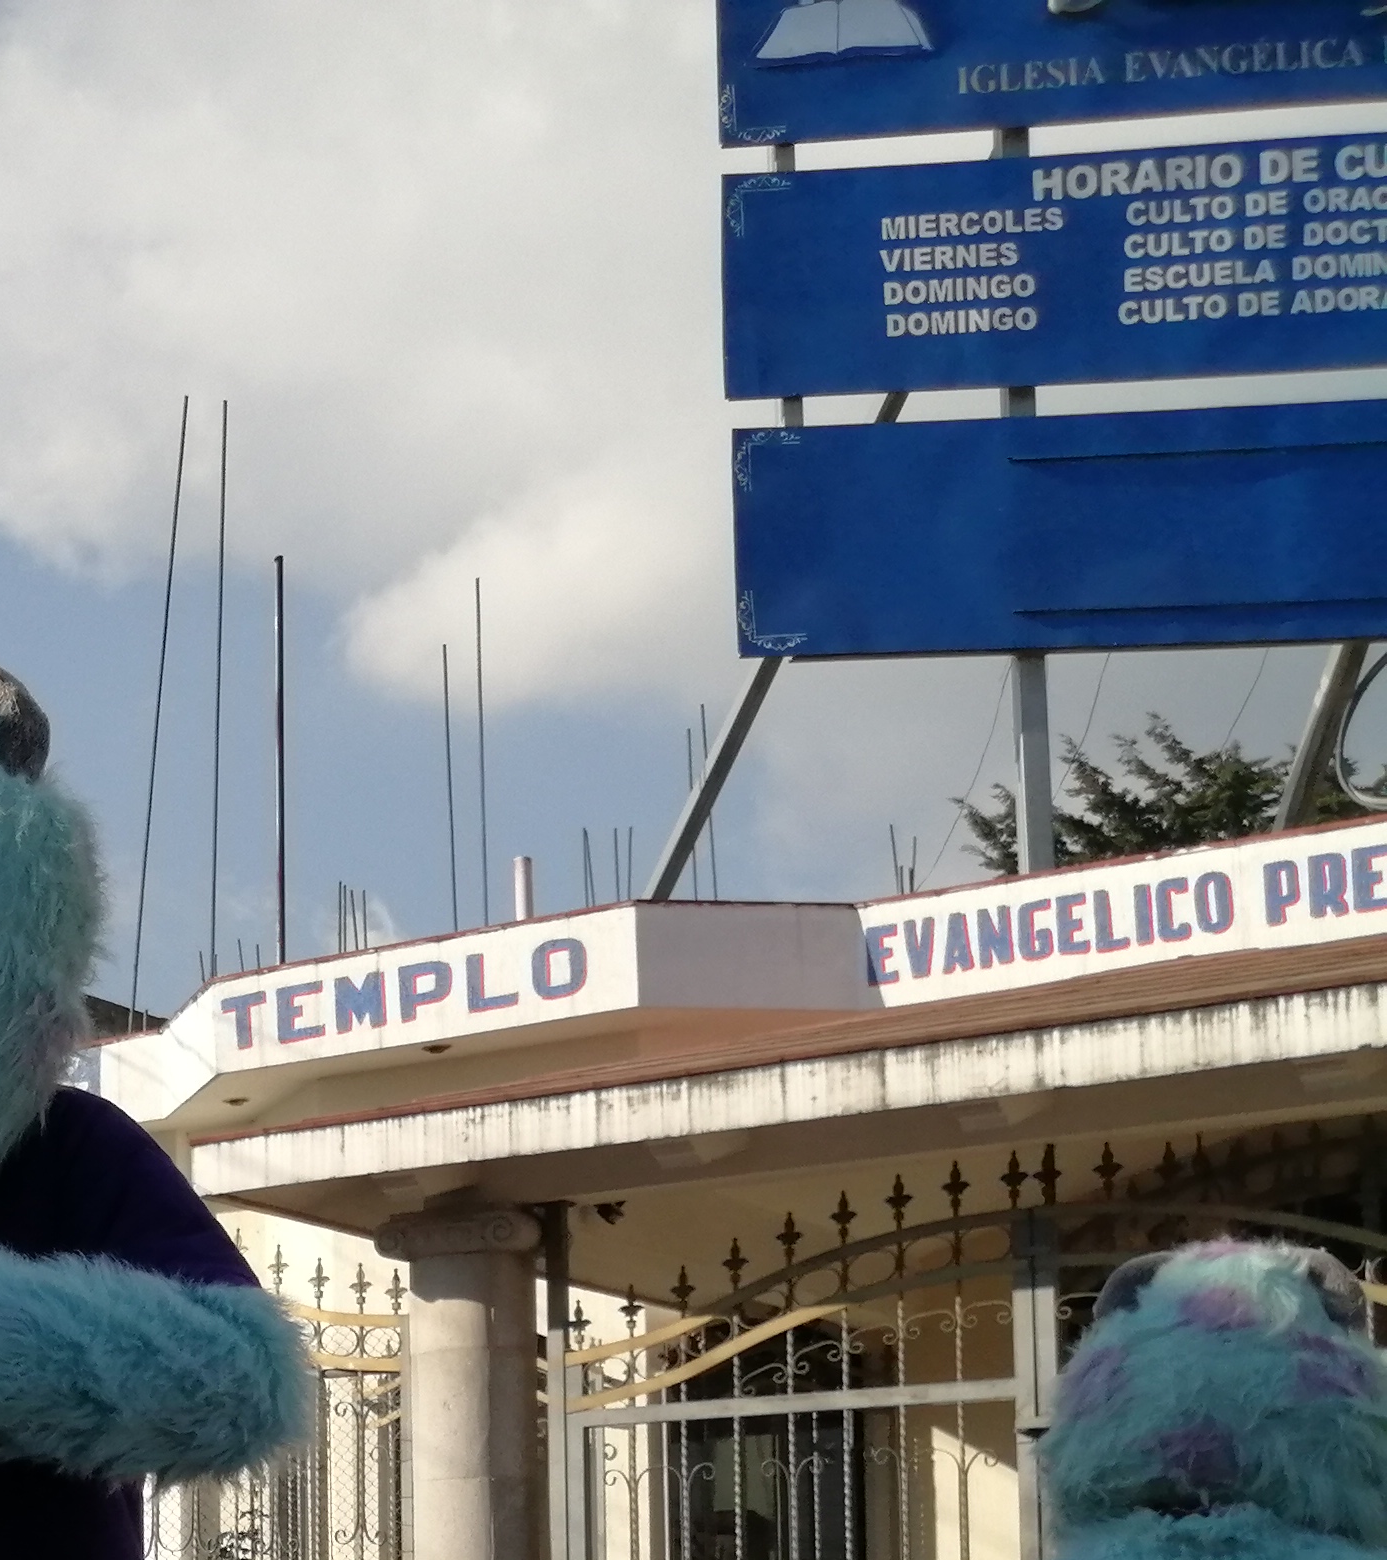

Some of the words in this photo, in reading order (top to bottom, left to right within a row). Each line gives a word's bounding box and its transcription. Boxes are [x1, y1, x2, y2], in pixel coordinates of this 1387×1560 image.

[957, 56, 1105, 95] IGLESIA
[1032, 154, 1242, 201] HORARIO
[1259, 149, 1319, 185] DE
[881, 207, 1064, 240] MIERCOLES
[1127, 196, 1233, 226] CULTO
[1245, 190, 1288, 217] DE
[879, 242, 1019, 273] VIERNES
[1124, 229, 1232, 258] CULTO
[1244, 224, 1287, 249] DE
[883, 273, 1036, 306] DOMINGO
[1124, 260, 1275, 292] ESCUELA
[886, 306, 1038, 337] DOMINGO
[1118, 295, 1228, 325] CULTO
[1238, 290, 1281, 317] DE
[1290, 285, 1387, 314] ADOR
[865, 871, 1234, 986] EVANGELICO
[1263, 844, 1387, 926] PRE
[221, 938, 588, 1051] TEMPLO
